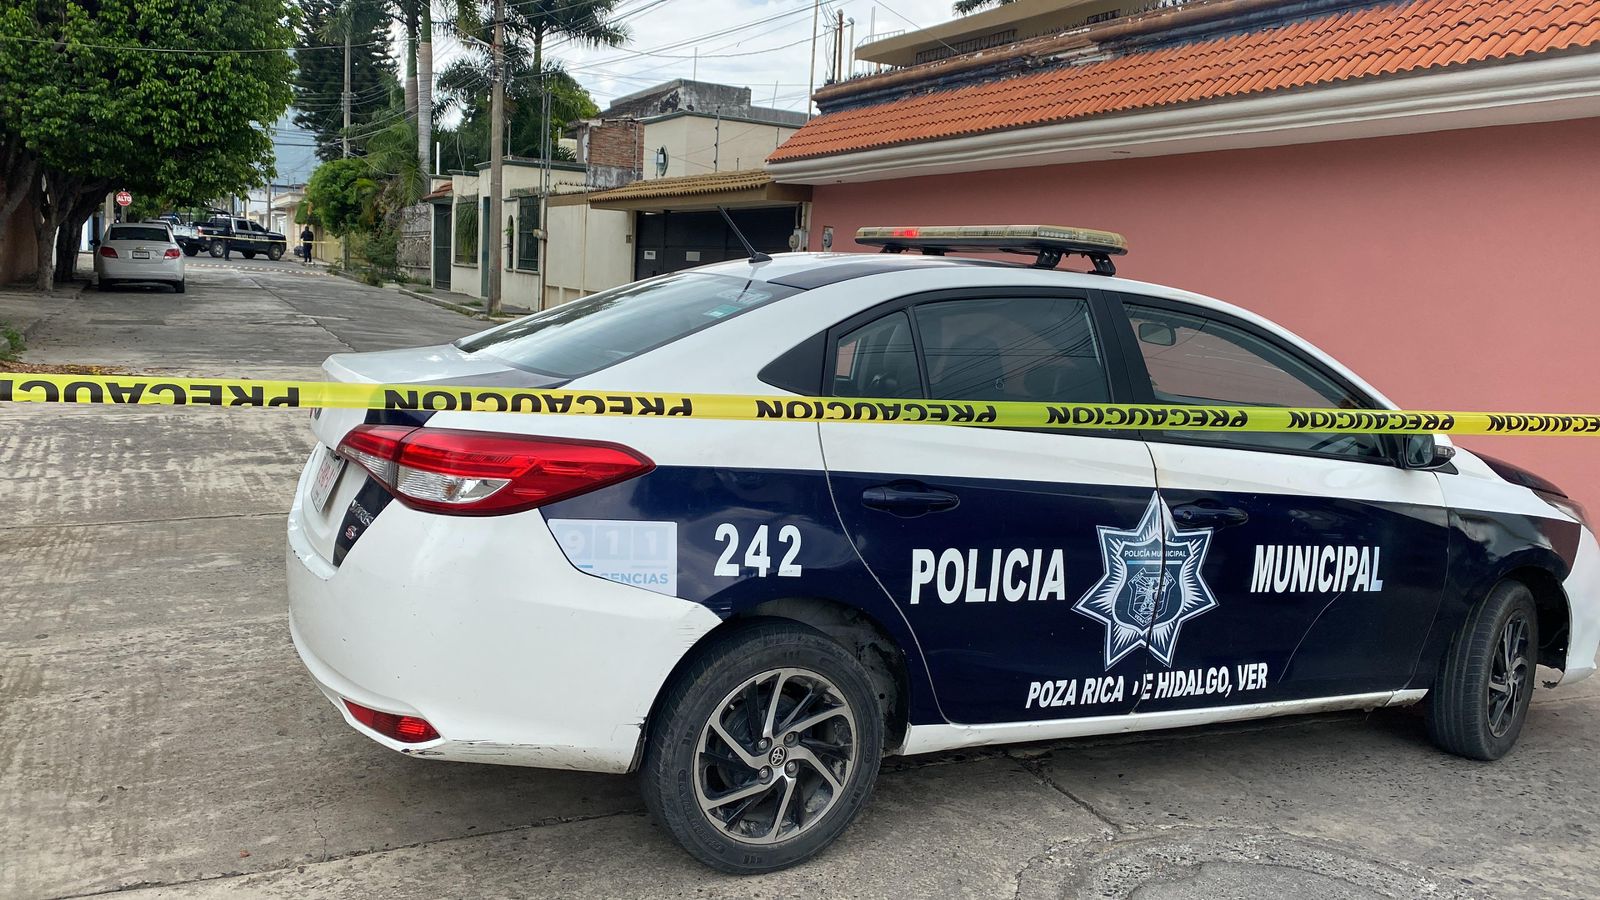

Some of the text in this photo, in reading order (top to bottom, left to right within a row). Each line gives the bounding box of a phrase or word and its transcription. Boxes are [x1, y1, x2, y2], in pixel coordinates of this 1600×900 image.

[563, 529, 658, 552] 911
[714, 523, 802, 577] 242
[910, 545, 1384, 604] POLICIA MUNICIPAL
[1026, 678, 1076, 708] POZA
[1079, 675, 1125, 705] RICA
[1155, 666, 1233, 698] HIDALGO,
[1238, 663, 1268, 690] VER
